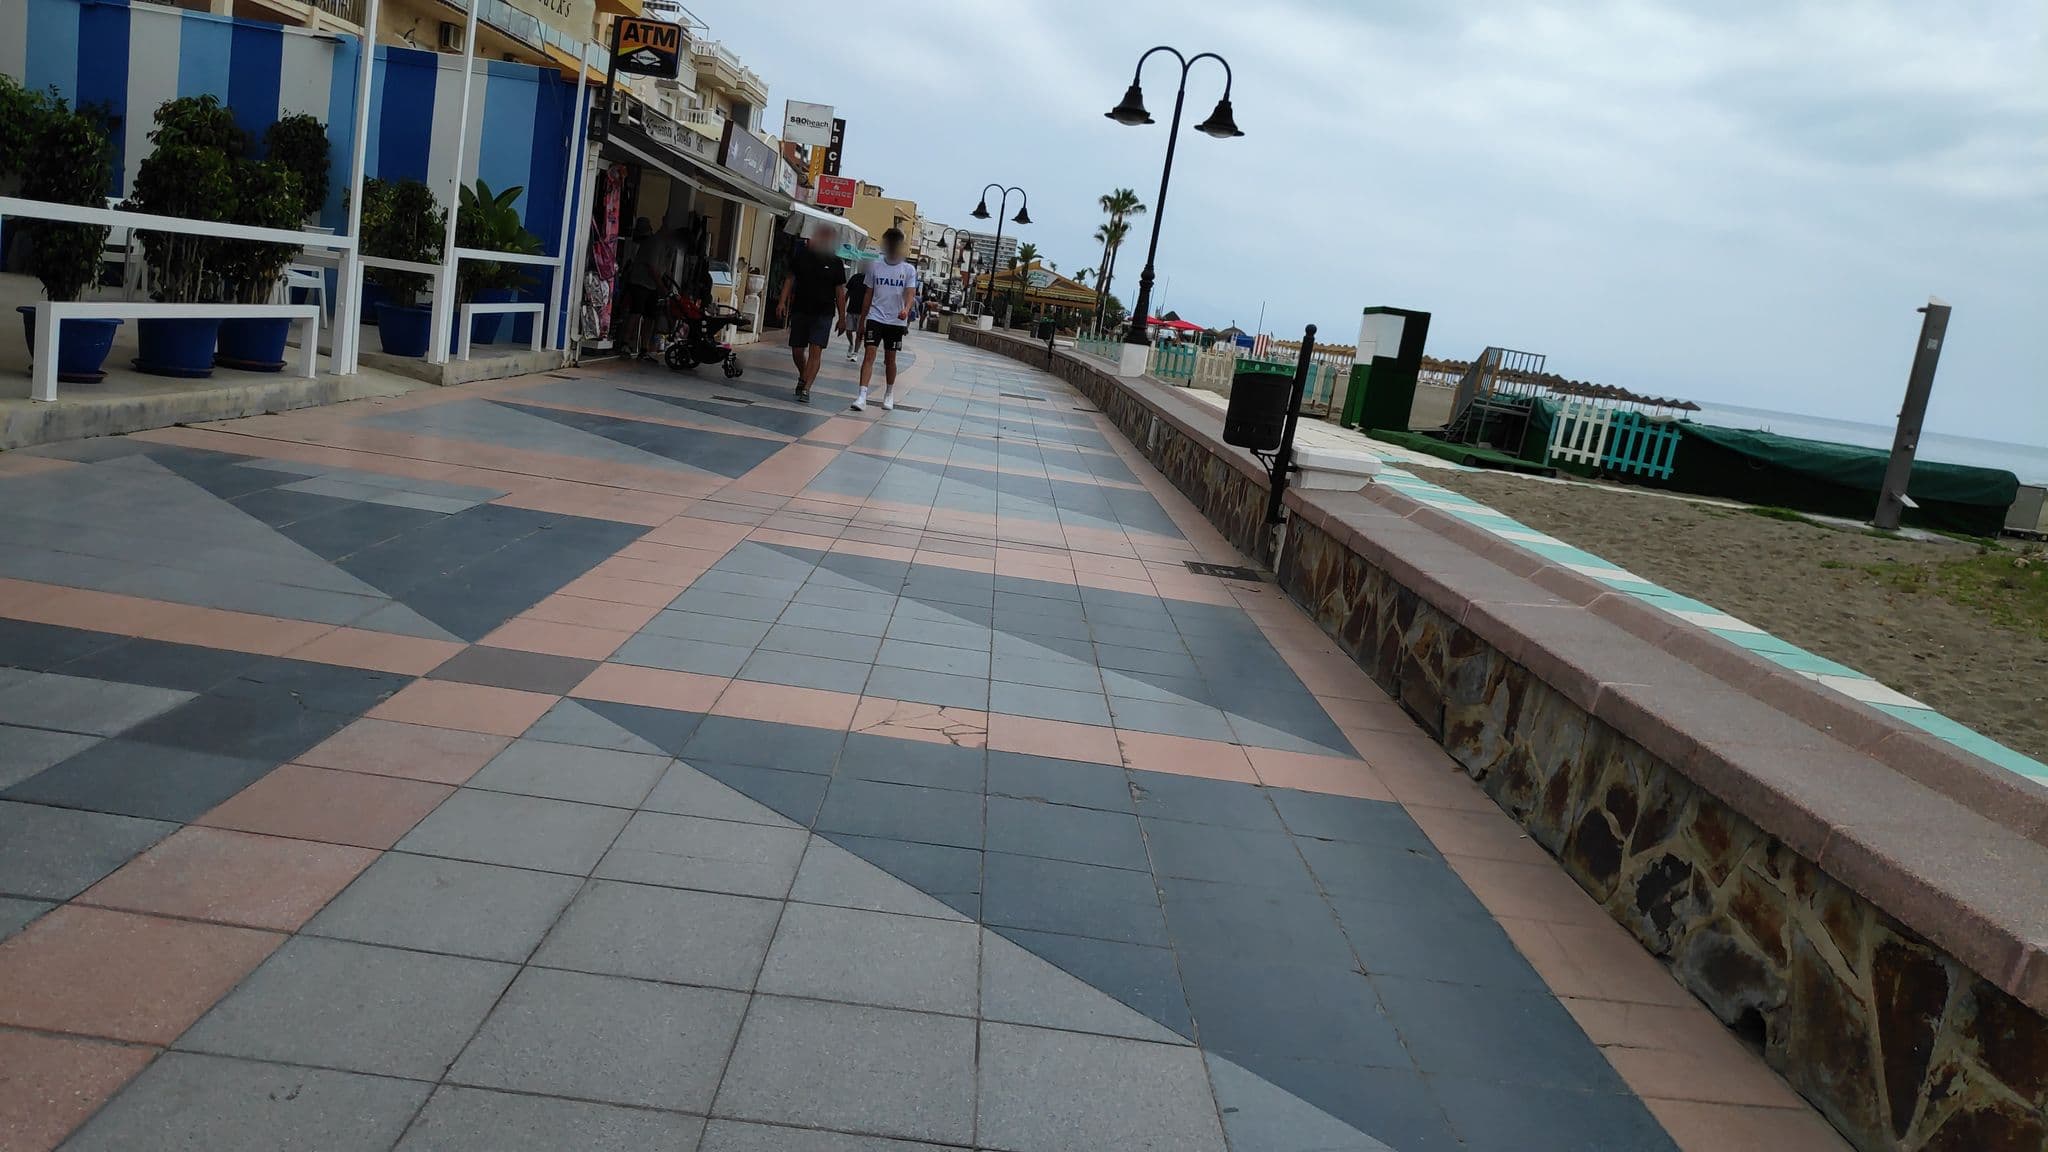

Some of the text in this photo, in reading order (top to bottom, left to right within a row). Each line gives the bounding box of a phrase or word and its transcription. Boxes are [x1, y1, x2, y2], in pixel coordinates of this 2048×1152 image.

[623, 22, 677, 49] ATM
[832, 121, 841, 144] La
[876, 277, 904, 287] ITALIA
